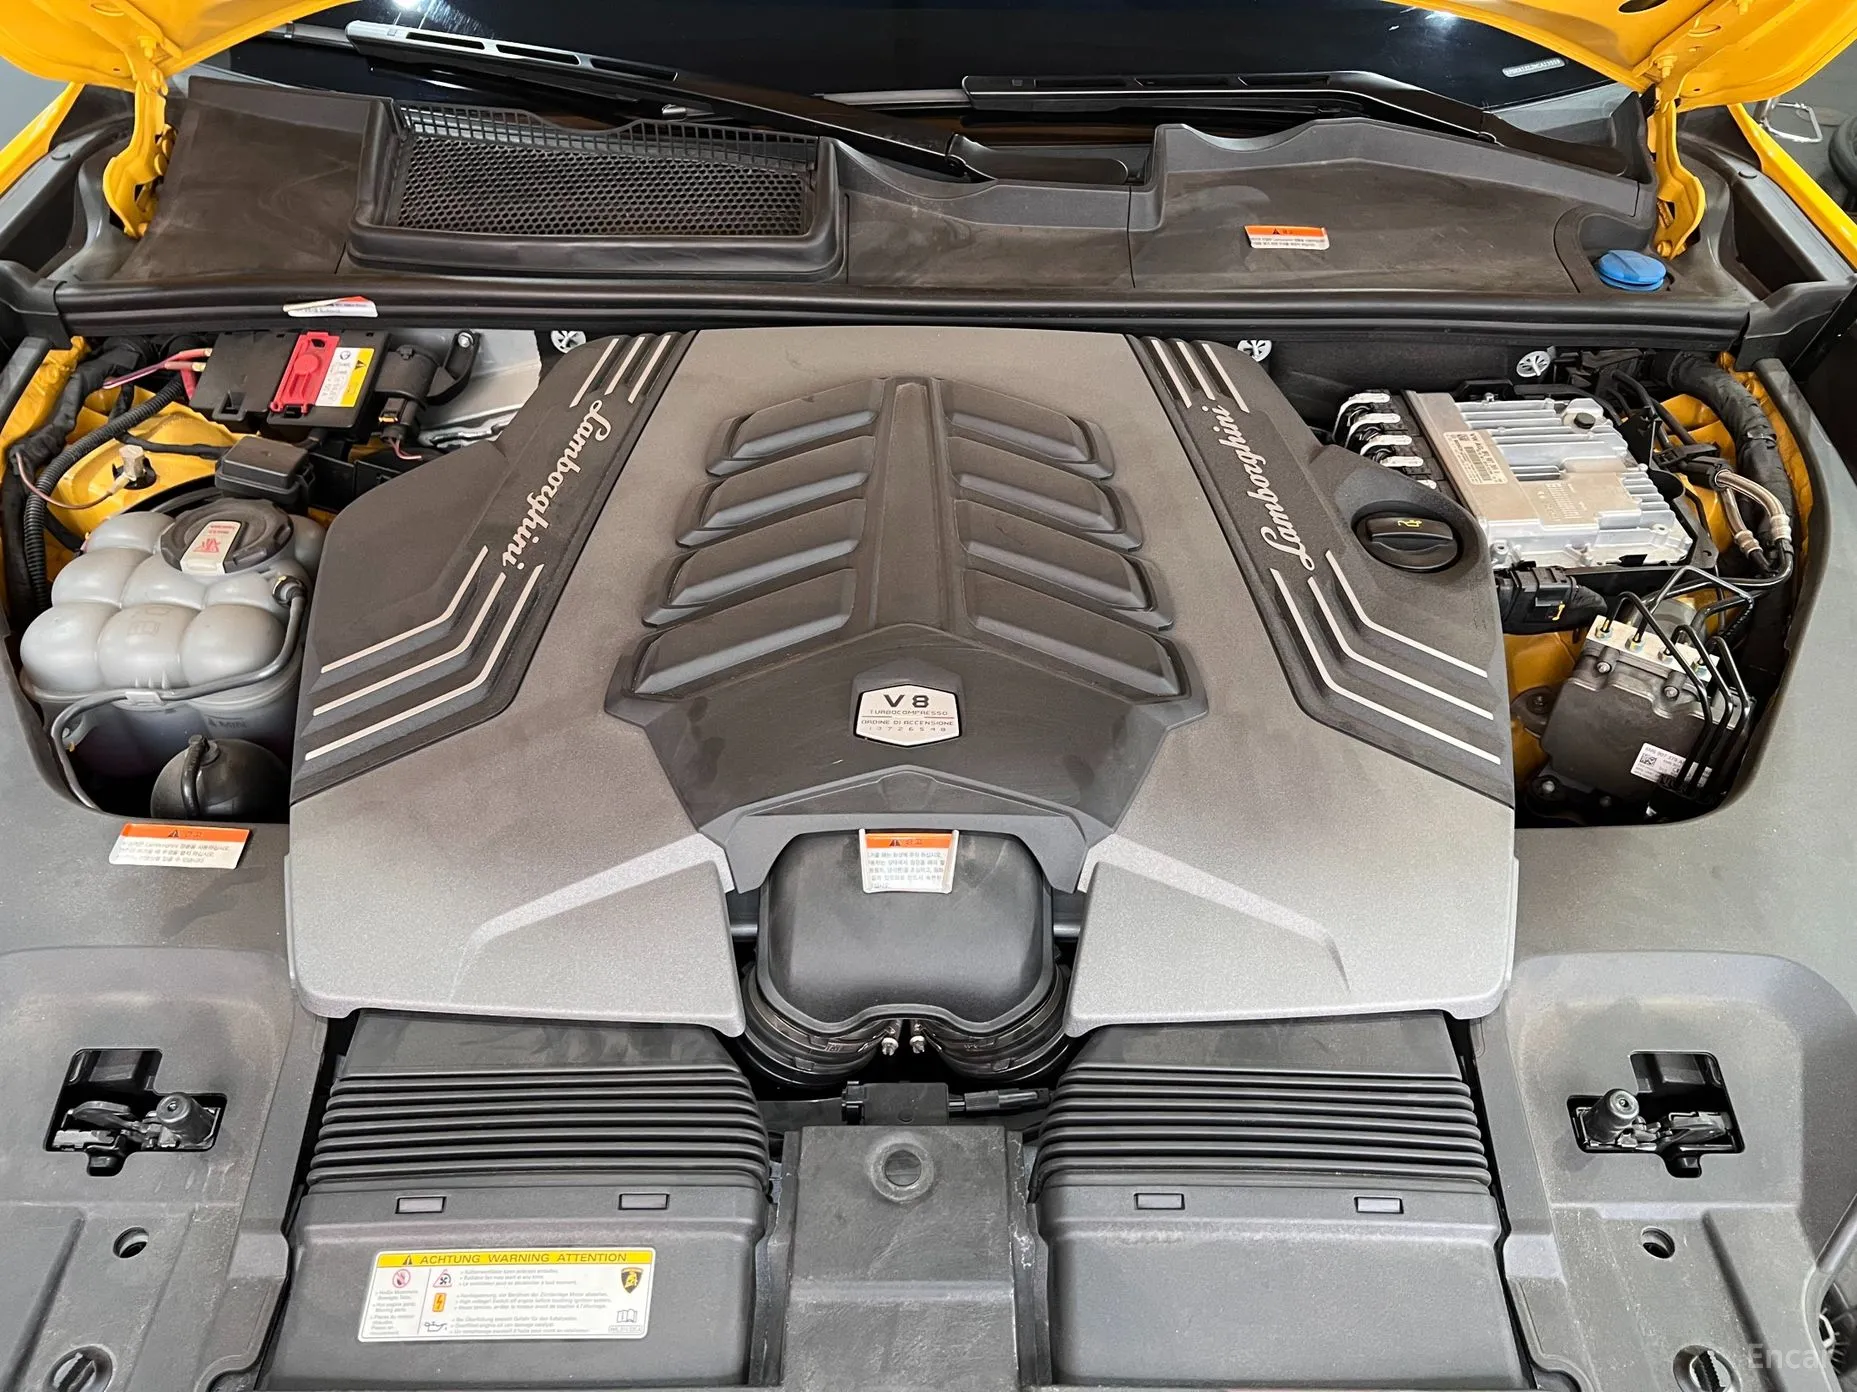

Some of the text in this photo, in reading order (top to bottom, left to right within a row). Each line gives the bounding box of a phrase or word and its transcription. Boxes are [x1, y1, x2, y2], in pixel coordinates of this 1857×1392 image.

[503, 400, 611, 570] Lamborghini
[1202, 405, 1315, 571] Lamborghini
[420, 1253, 628, 1264] ACHTUNG WARNING ATTENTION
